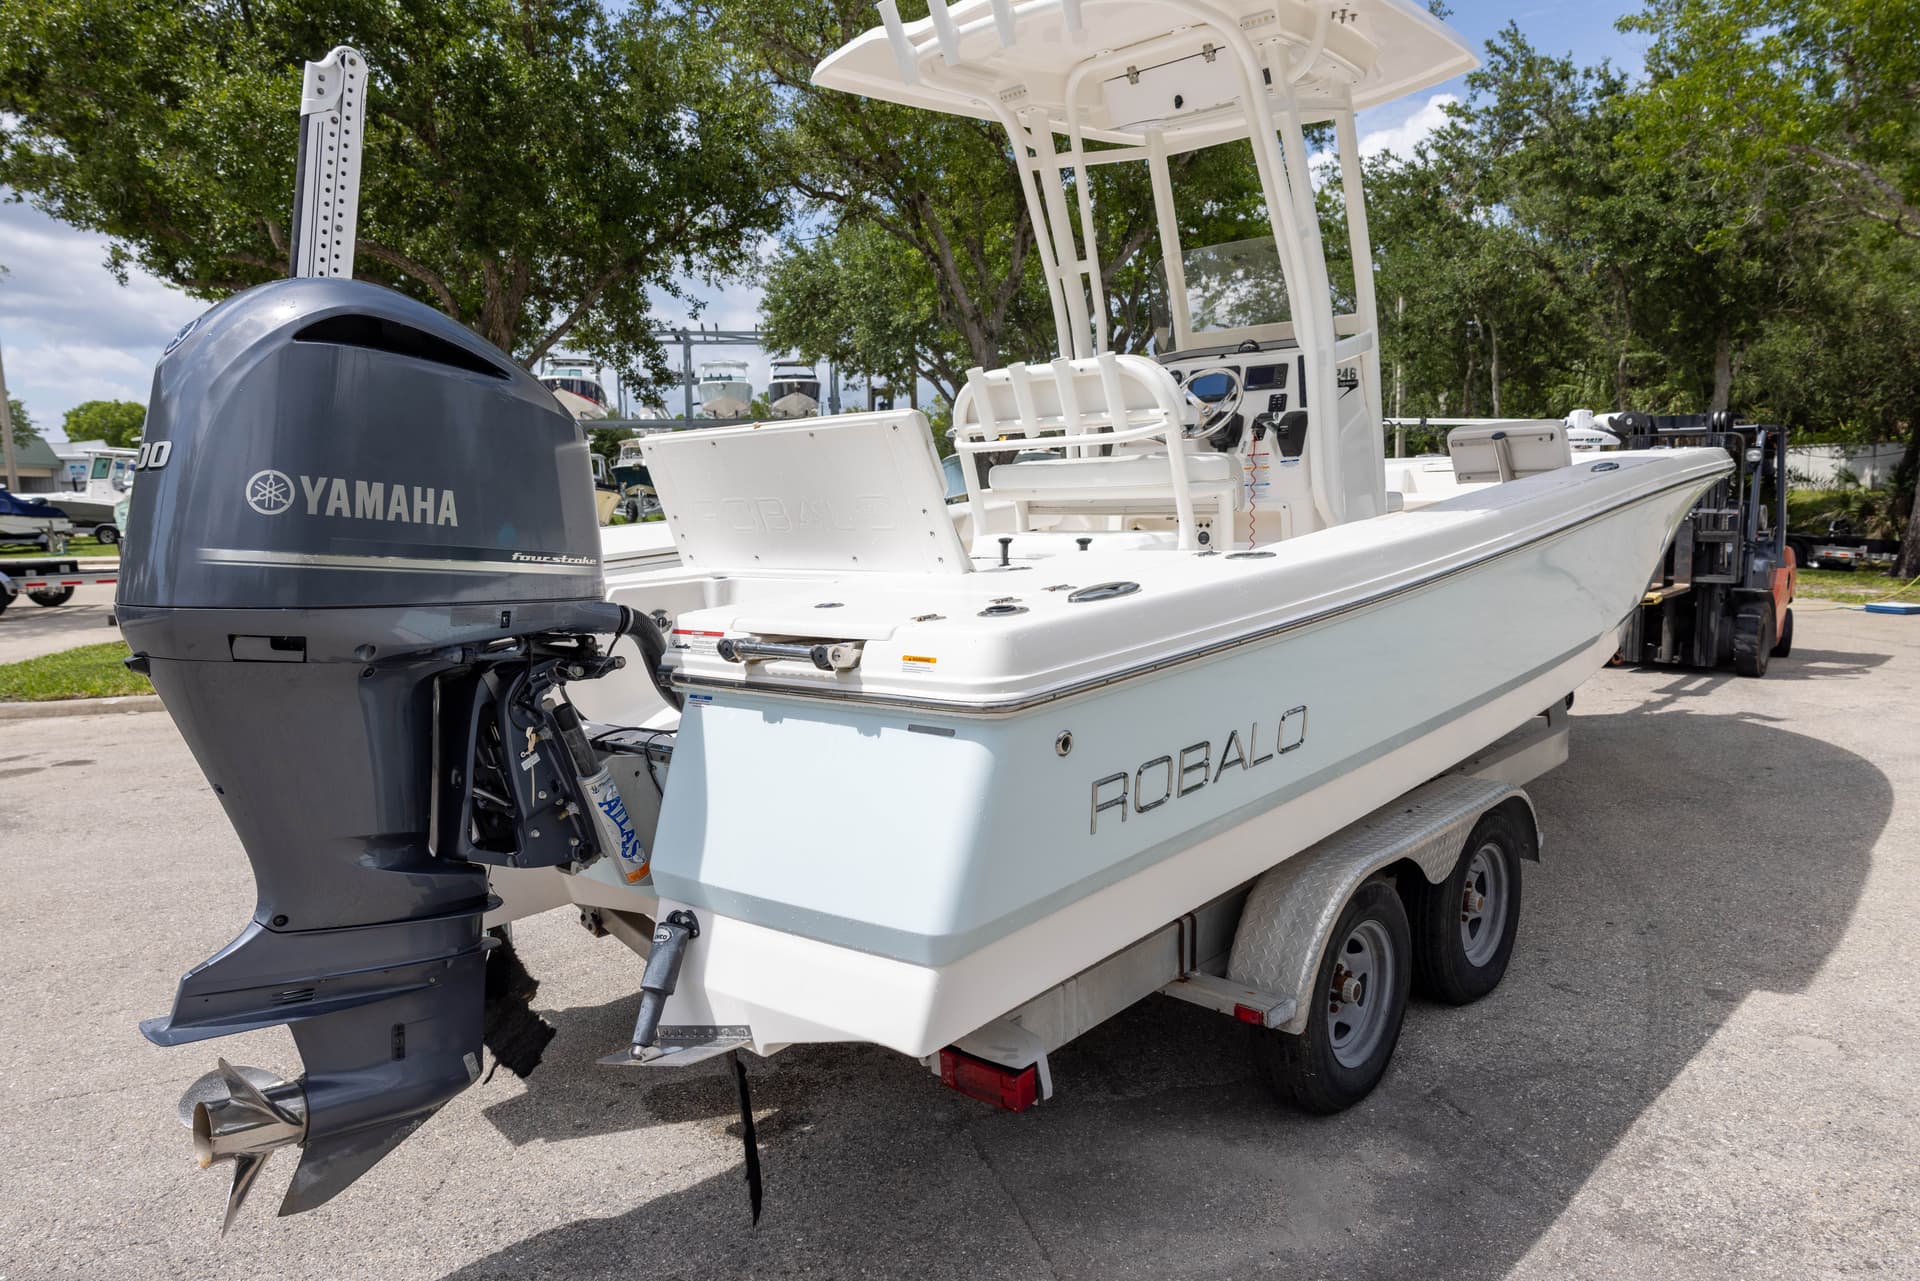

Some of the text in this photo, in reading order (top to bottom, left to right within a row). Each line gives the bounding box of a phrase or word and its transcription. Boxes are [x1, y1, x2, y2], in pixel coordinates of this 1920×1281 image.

[300, 475, 459, 527] YAMAHA
[511, 552, 597, 565] fourstroke
[1090, 704, 1309, 835] ROBALO
[598, 796, 641, 859] ATLAS
